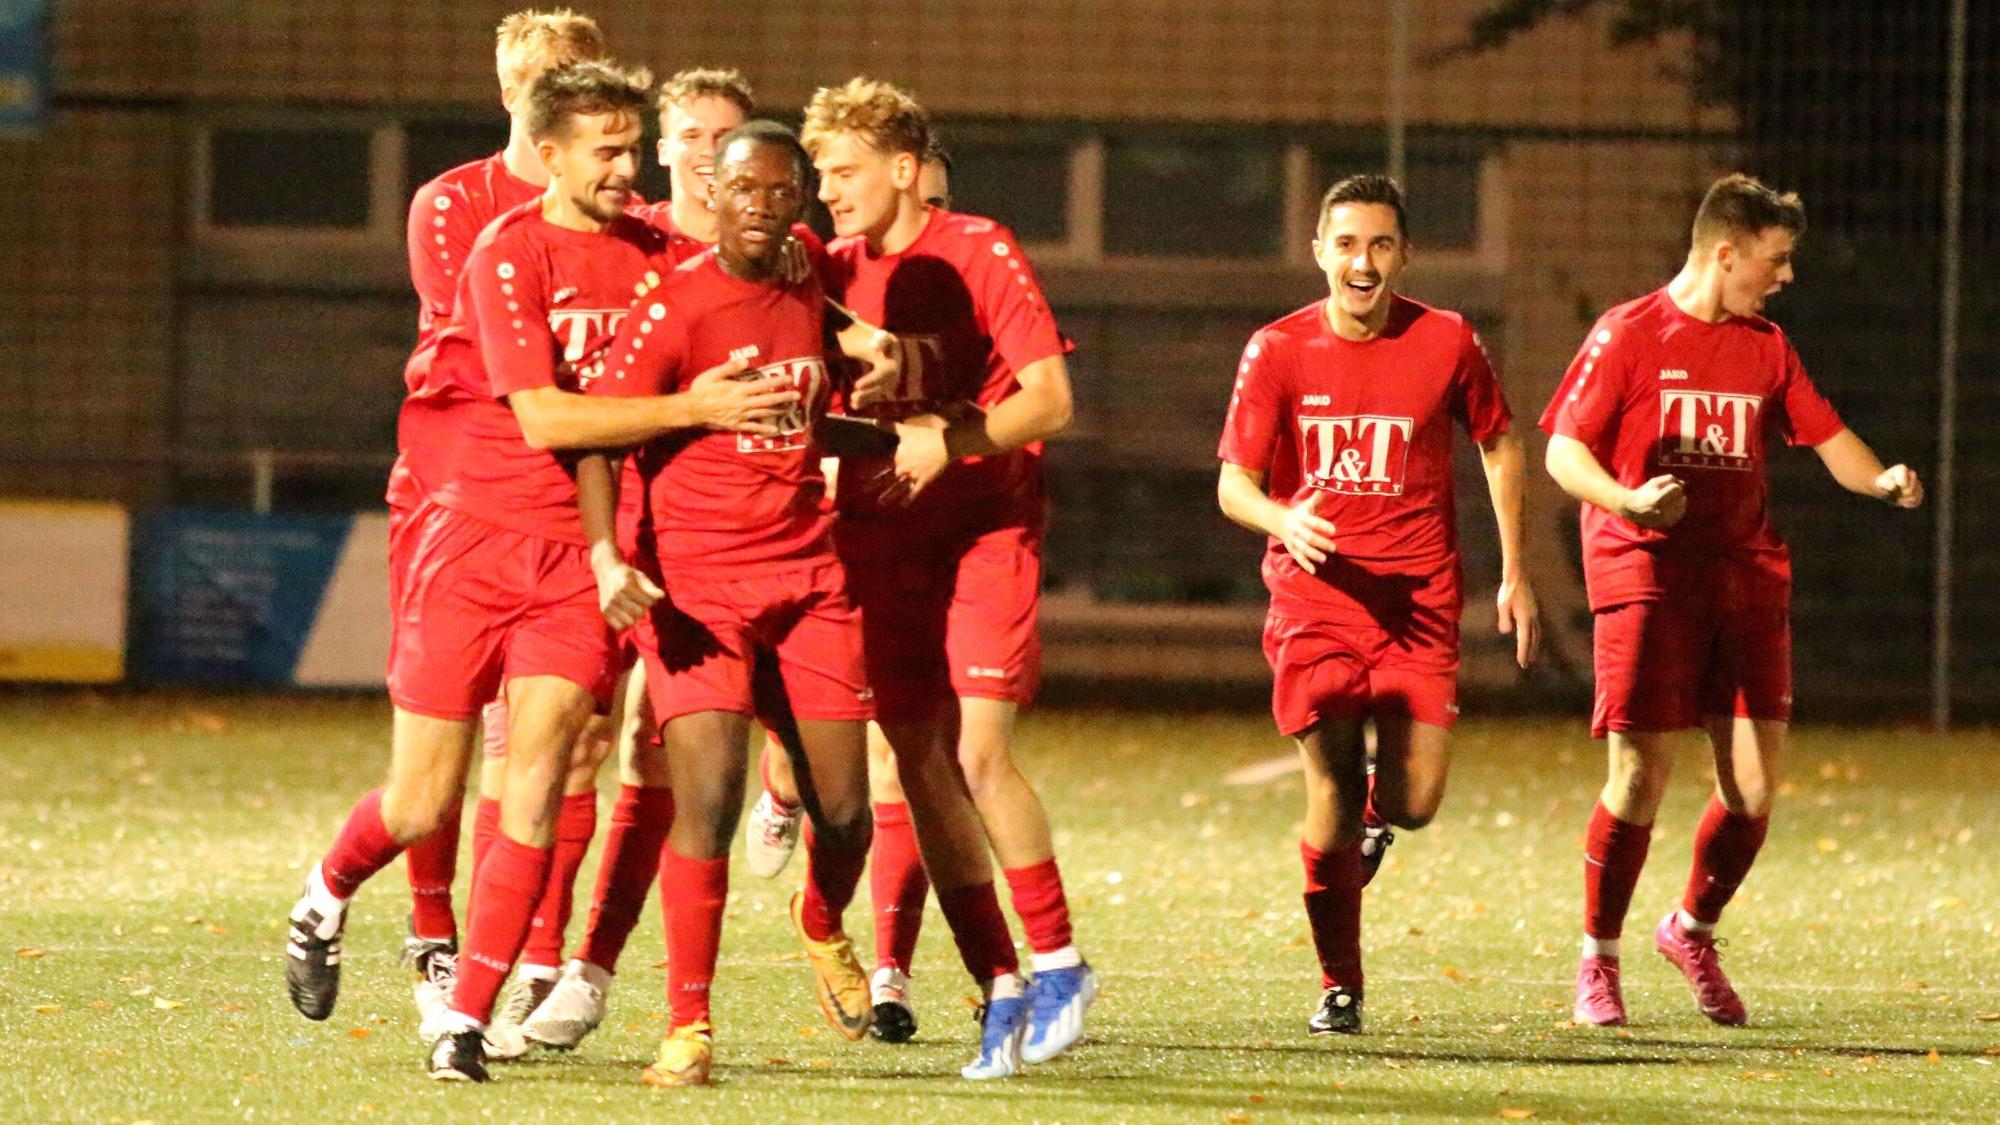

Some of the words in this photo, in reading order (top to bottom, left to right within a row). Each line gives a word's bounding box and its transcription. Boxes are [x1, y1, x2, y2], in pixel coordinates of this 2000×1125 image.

[1661, 369, 1689, 380] JAKO
[1302, 394, 1331, 406] JAKO
[1663, 393, 1762, 458] T&T
[1301, 418, 1411, 483] T&T
